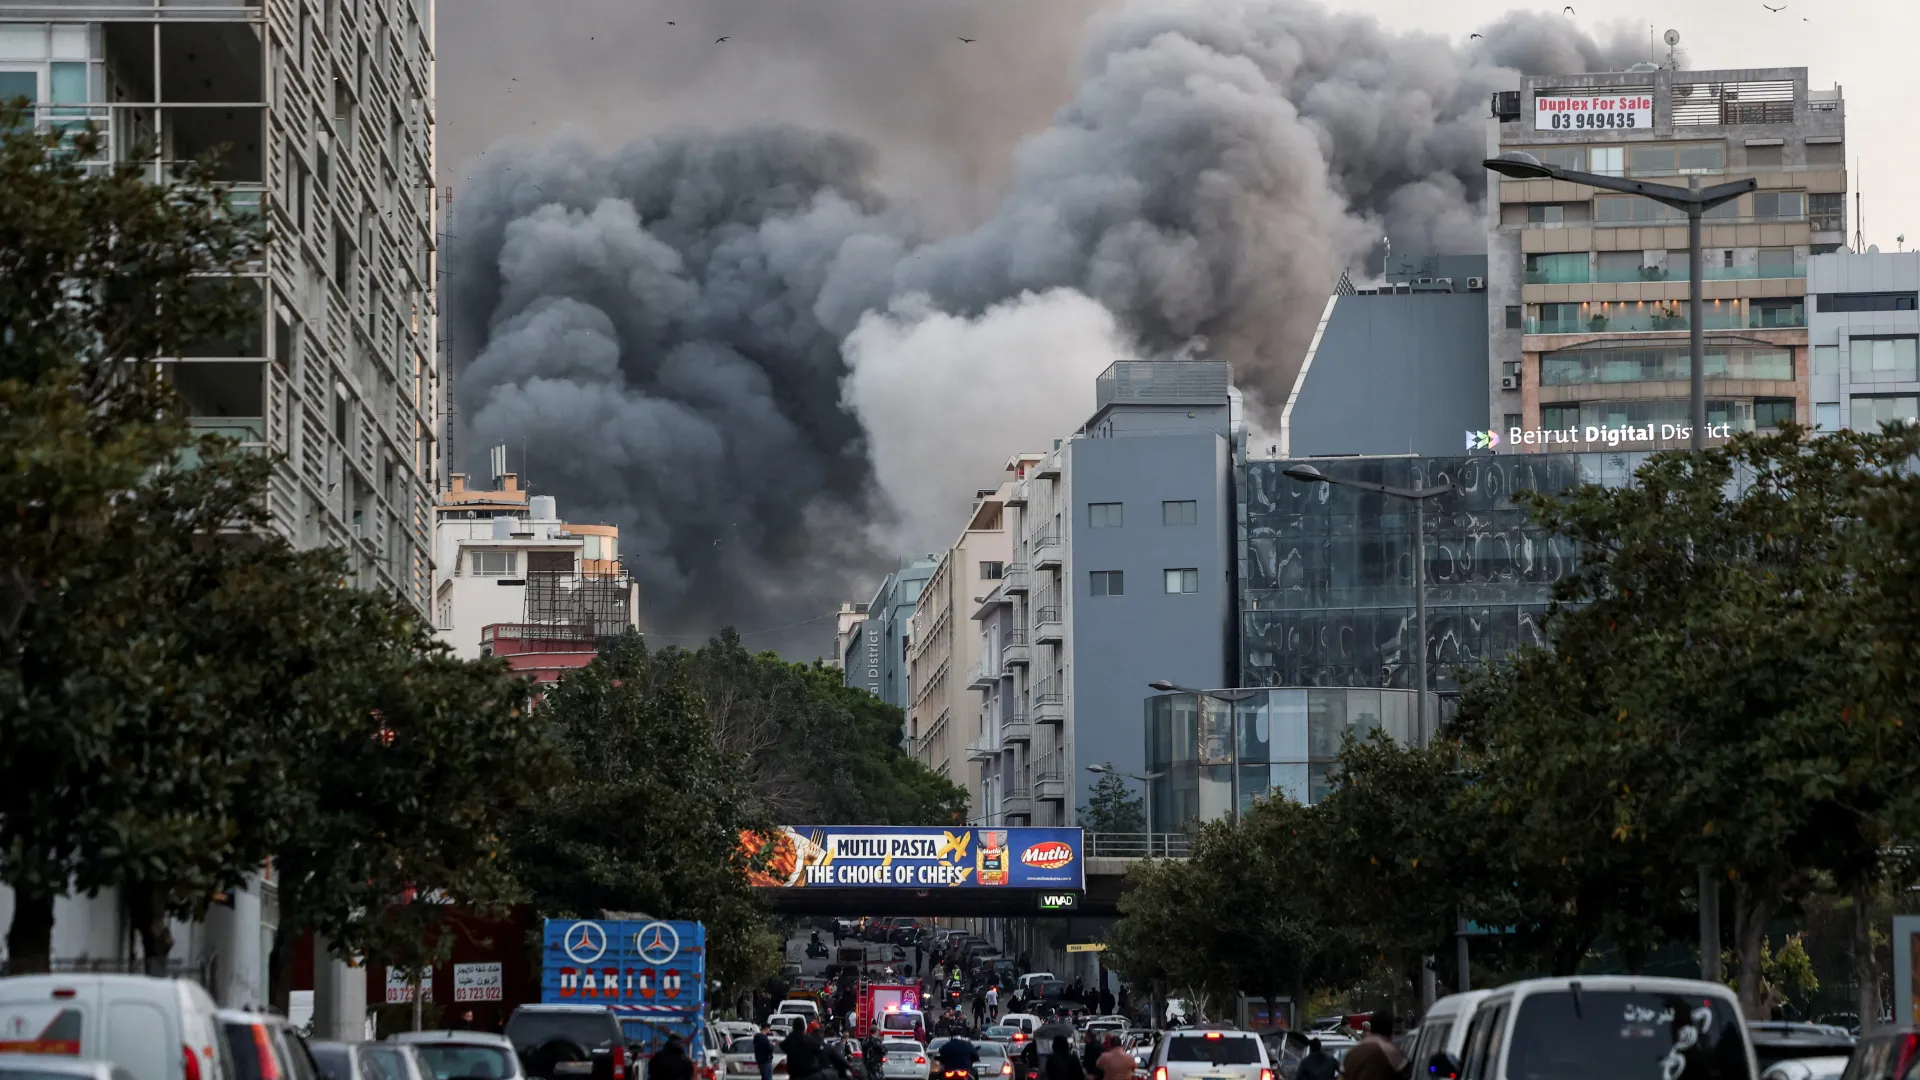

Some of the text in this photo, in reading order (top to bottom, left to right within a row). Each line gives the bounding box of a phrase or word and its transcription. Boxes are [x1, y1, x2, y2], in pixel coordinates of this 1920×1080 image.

[1539, 96, 1651, 113] Duplex For Sale
[1552, 112, 1635, 129] 03 949435
[1510, 425, 1579, 445] Beirut
[1585, 423, 1655, 447] Digital
[868, 630, 879, 679] District
[837, 839, 937, 856] MUTLU PASTA
[983, 846, 1001, 855] Mutlu
[1022, 846, 1070, 863] Mutlu
[806, 865, 964, 884] THE CHOICE OF CHEFS
[559, 967, 681, 999] DARICO
[387, 987, 398, 1001] 03
[456, 986, 501, 1000] 03 723 022
